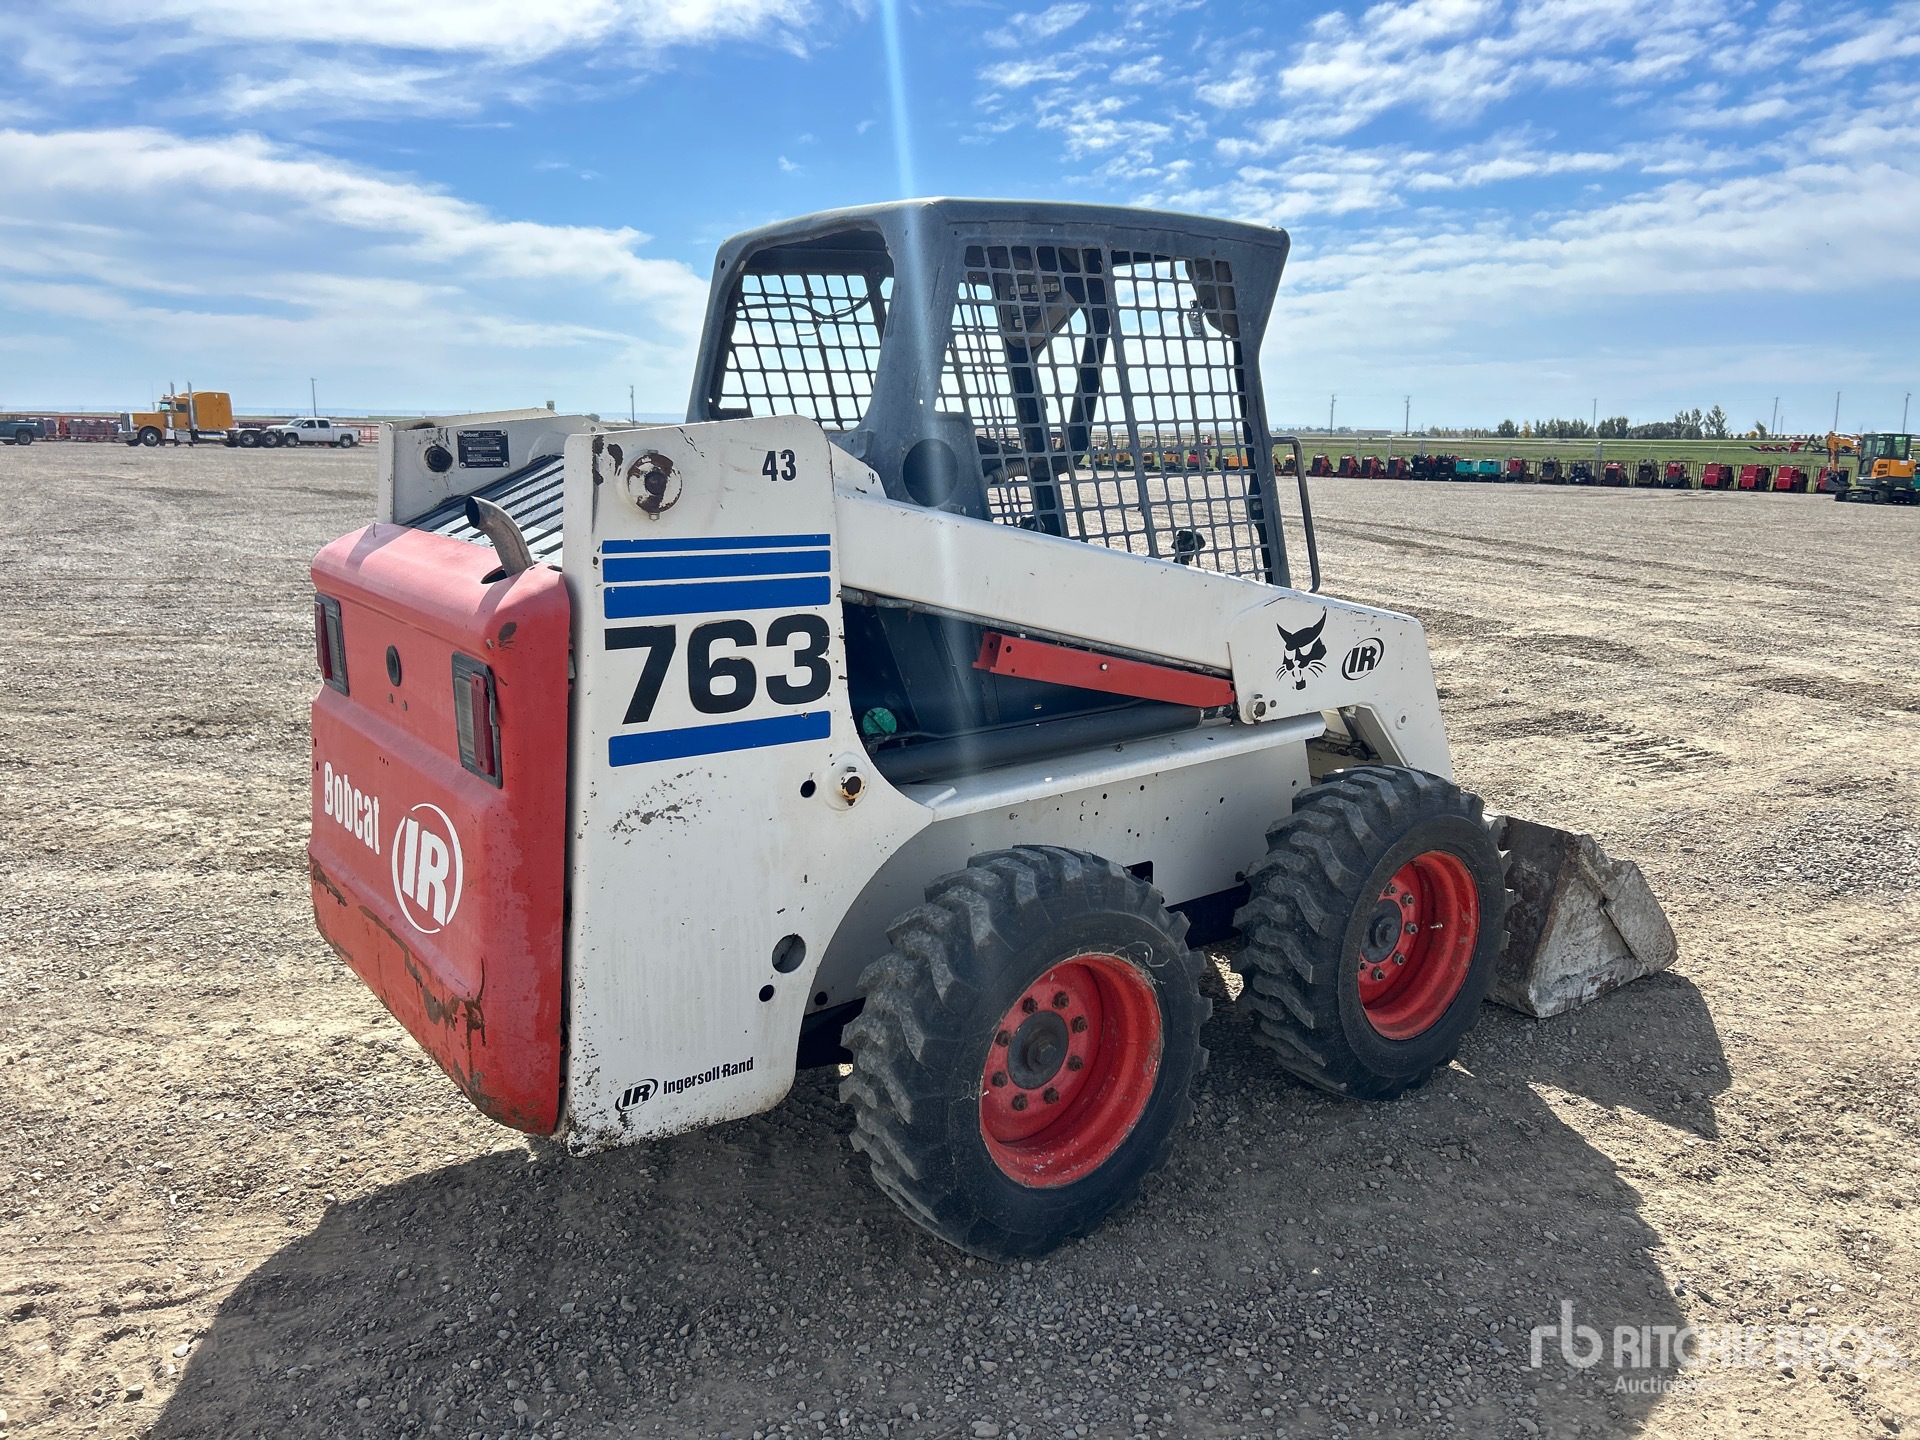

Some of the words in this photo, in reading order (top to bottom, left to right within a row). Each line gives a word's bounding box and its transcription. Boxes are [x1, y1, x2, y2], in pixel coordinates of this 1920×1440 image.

[762, 449, 797, 482] 43
[604, 613, 832, 725] 763
[324, 761, 380, 855] Bobcat
